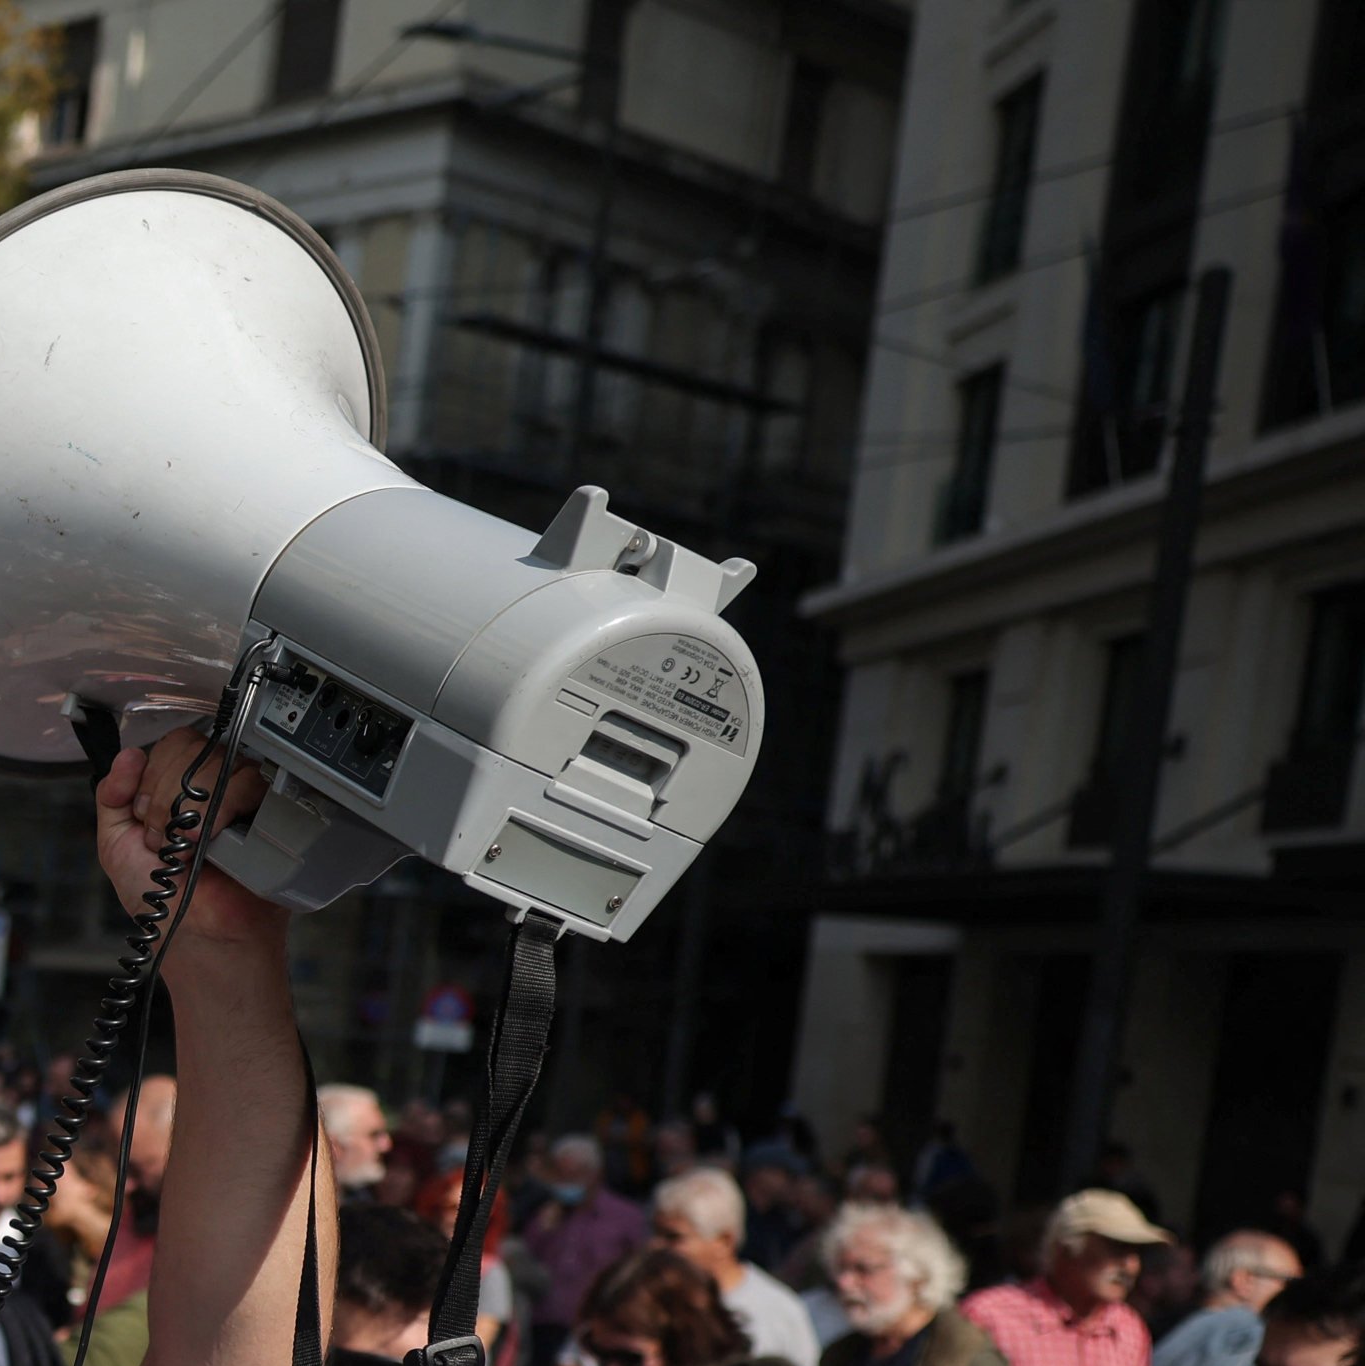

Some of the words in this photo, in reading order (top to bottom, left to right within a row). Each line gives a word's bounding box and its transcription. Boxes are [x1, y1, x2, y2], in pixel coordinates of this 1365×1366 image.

[671, 644, 703, 663] Corporation
[641, 699, 678, 720] MEGAPHONE
[678, 706, 699, 719] POWER
[678, 716, 701, 731] POWER
[699, 715, 721, 729] OUTPUT
[701, 726, 717, 737] HIGH
